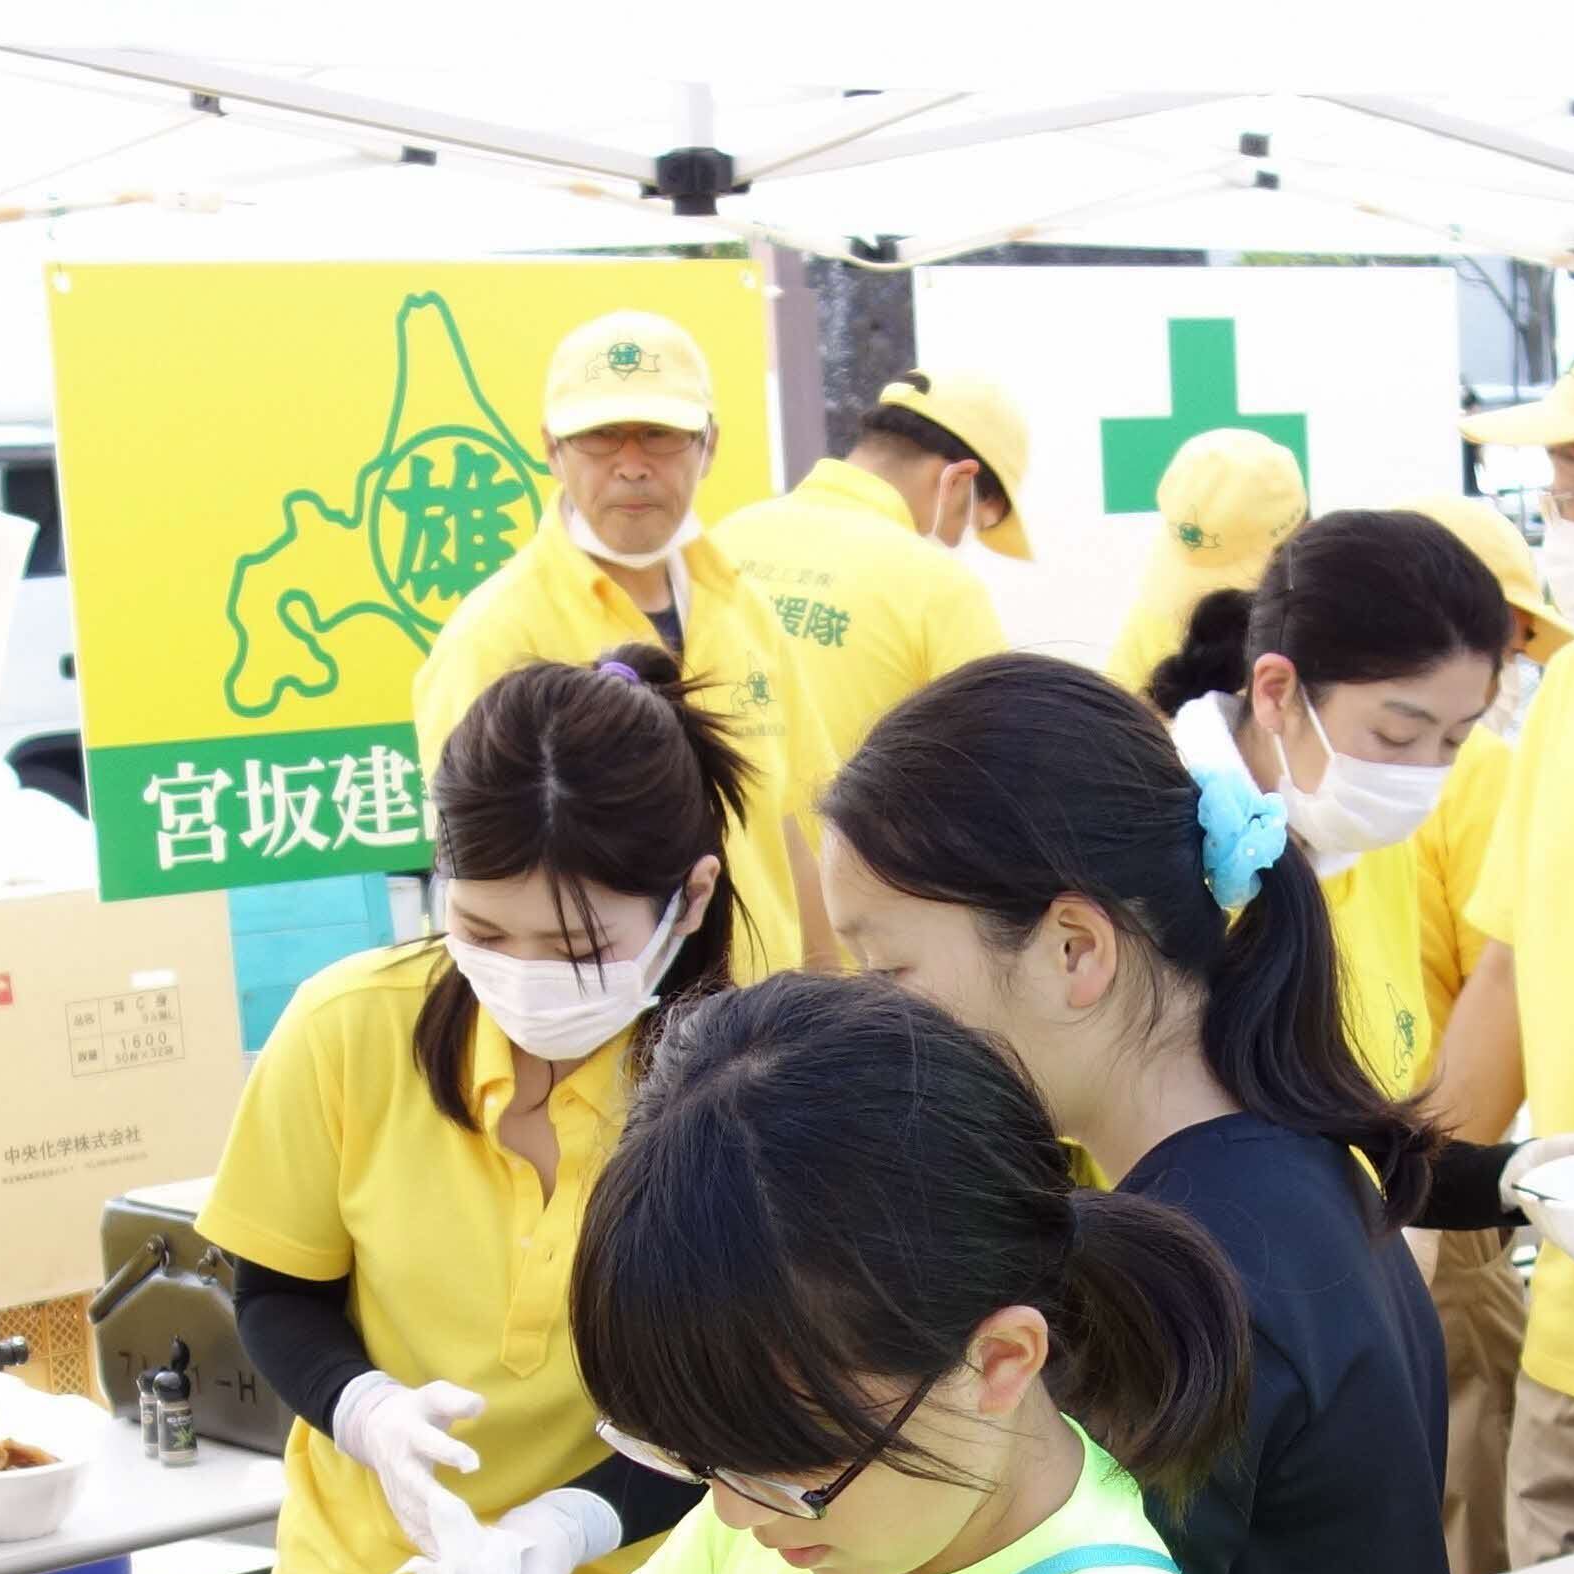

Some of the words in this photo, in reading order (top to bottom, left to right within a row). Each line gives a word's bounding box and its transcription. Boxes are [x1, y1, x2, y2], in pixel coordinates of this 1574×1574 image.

[4, 1124, 142, 1166] 中央化学株式会社
